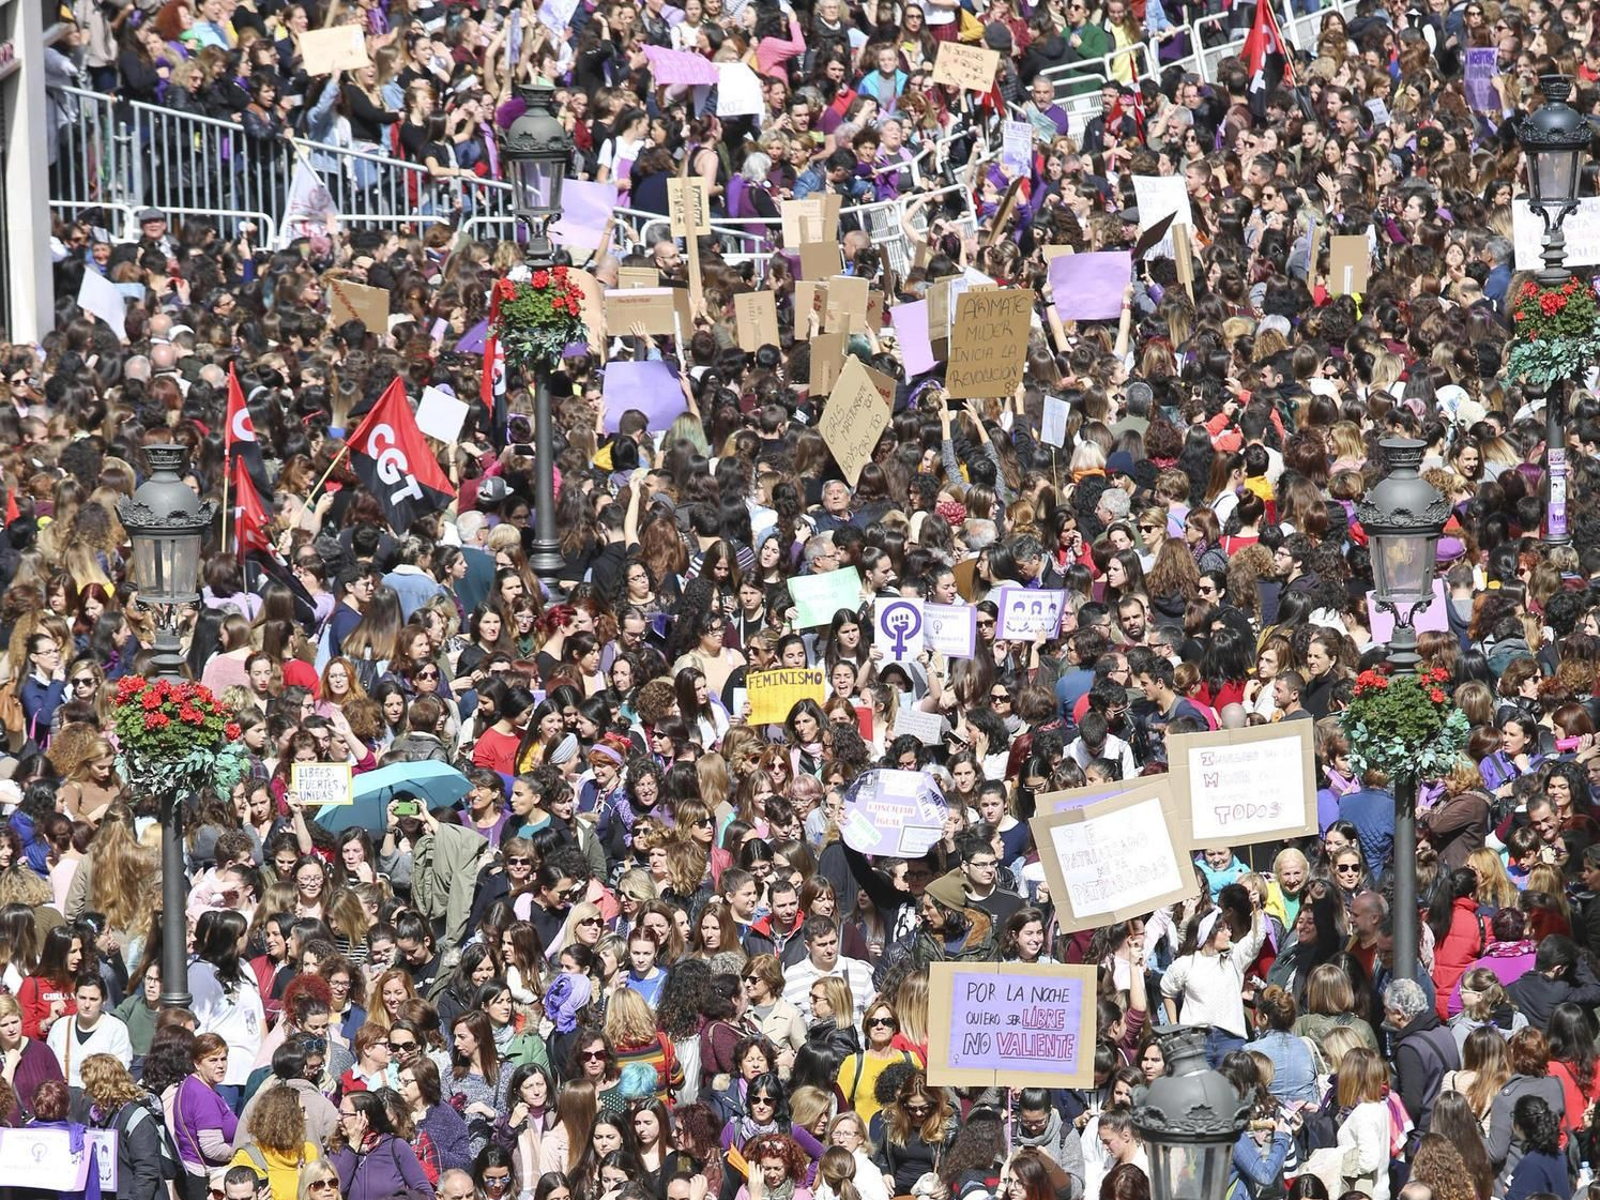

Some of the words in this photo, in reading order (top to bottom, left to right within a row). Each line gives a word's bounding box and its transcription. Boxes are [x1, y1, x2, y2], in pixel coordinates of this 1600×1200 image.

[367, 423, 424, 506] CGT
[748, 672, 823, 689] FEMINISMO
[299, 779, 339, 790] FUERTES
[300, 790, 334, 801] UNIDAS
[1214, 802, 1283, 825] TODOS
[967, 982, 996, 1003] POR
[1006, 983, 1024, 1002] LA
[1031, 986, 1070, 1003] NOCHE
[966, 1010, 1000, 1026] QUIERO
[963, 1032, 991, 1055] NO
[996, 1032, 1075, 1059] VALIENTE
